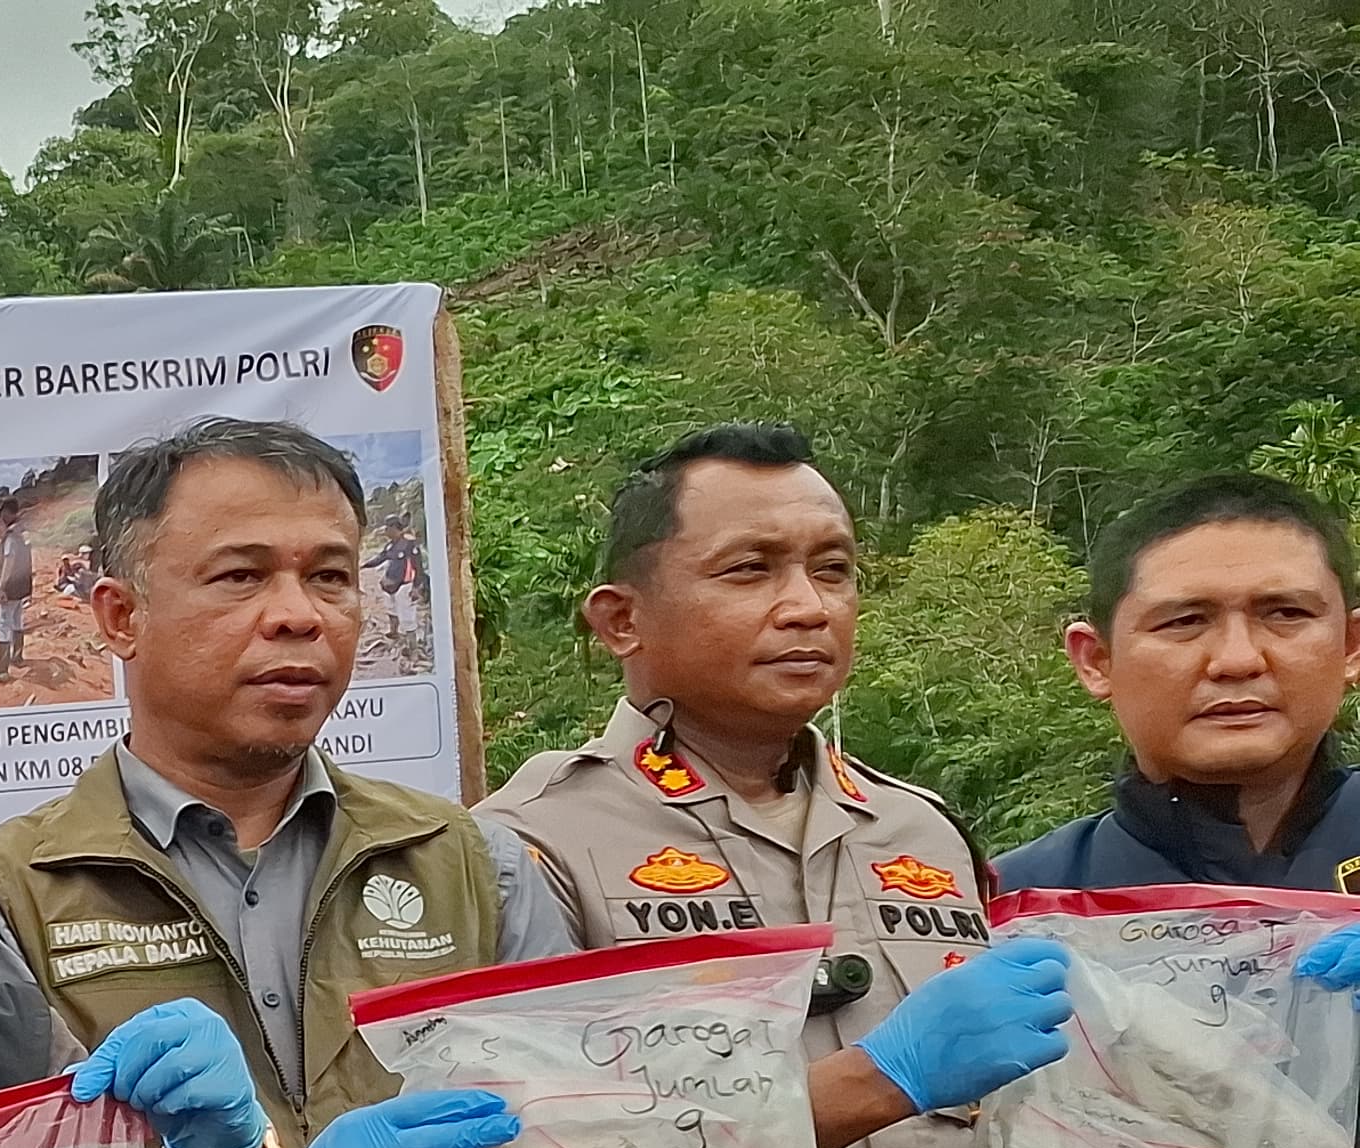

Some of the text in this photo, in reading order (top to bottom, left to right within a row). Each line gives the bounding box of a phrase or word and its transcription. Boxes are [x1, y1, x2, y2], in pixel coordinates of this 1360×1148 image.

[35, 356, 226, 397] BARESKRIM
[236, 347, 332, 384] POLRI
[15, 758, 54, 782] KM
[57, 756, 84, 778] 08
[54, 918, 203, 945] HARI NOVIANTO
[625, 900, 760, 933] YON.E
[878, 903, 990, 942] POLRI
[57, 937, 209, 977] KEPALA BALAI
[358, 932, 453, 952] KEHUTANAN
